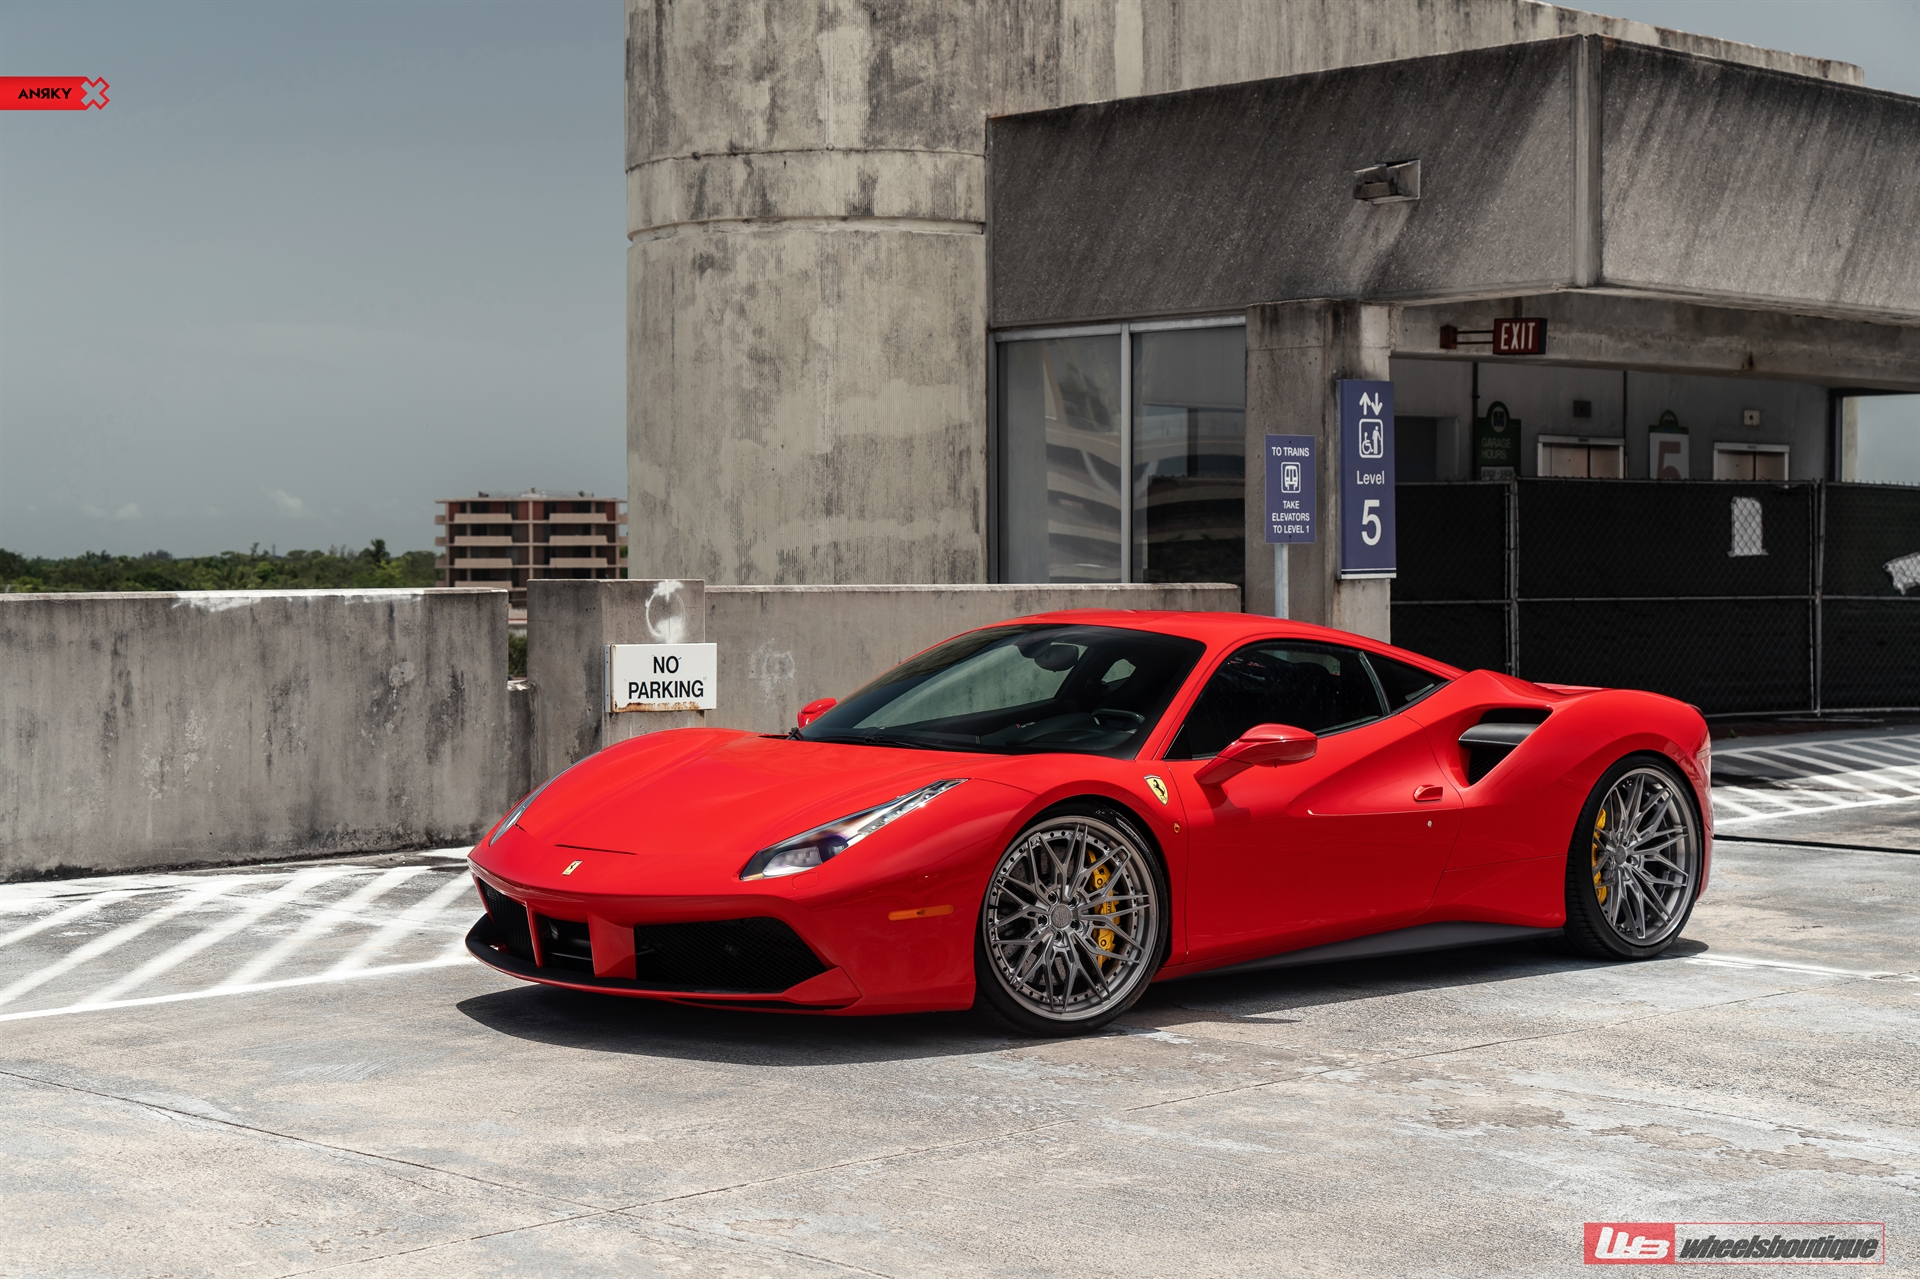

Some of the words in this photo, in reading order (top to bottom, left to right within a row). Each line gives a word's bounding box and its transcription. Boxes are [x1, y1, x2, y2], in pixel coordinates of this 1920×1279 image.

[1501, 322, 1536, 350] EXIT
[1482, 437, 1512, 448] GARAGE
[1272, 447, 1282, 456] TO
[1283, 447, 1310, 457] TRAINS
[1356, 470, 1385, 485] Level
[1283, 500, 1300, 509] TAKE
[1272, 512, 1310, 522] ELEVATORS
[1362, 500, 1382, 546] 5
[1273, 525, 1282, 534] TO
[1284, 525, 1304, 534] LEVEL
[1306, 525, 1310, 534] 1
[654, 656, 679, 674] NO
[628, 680, 704, 699] PARKING
